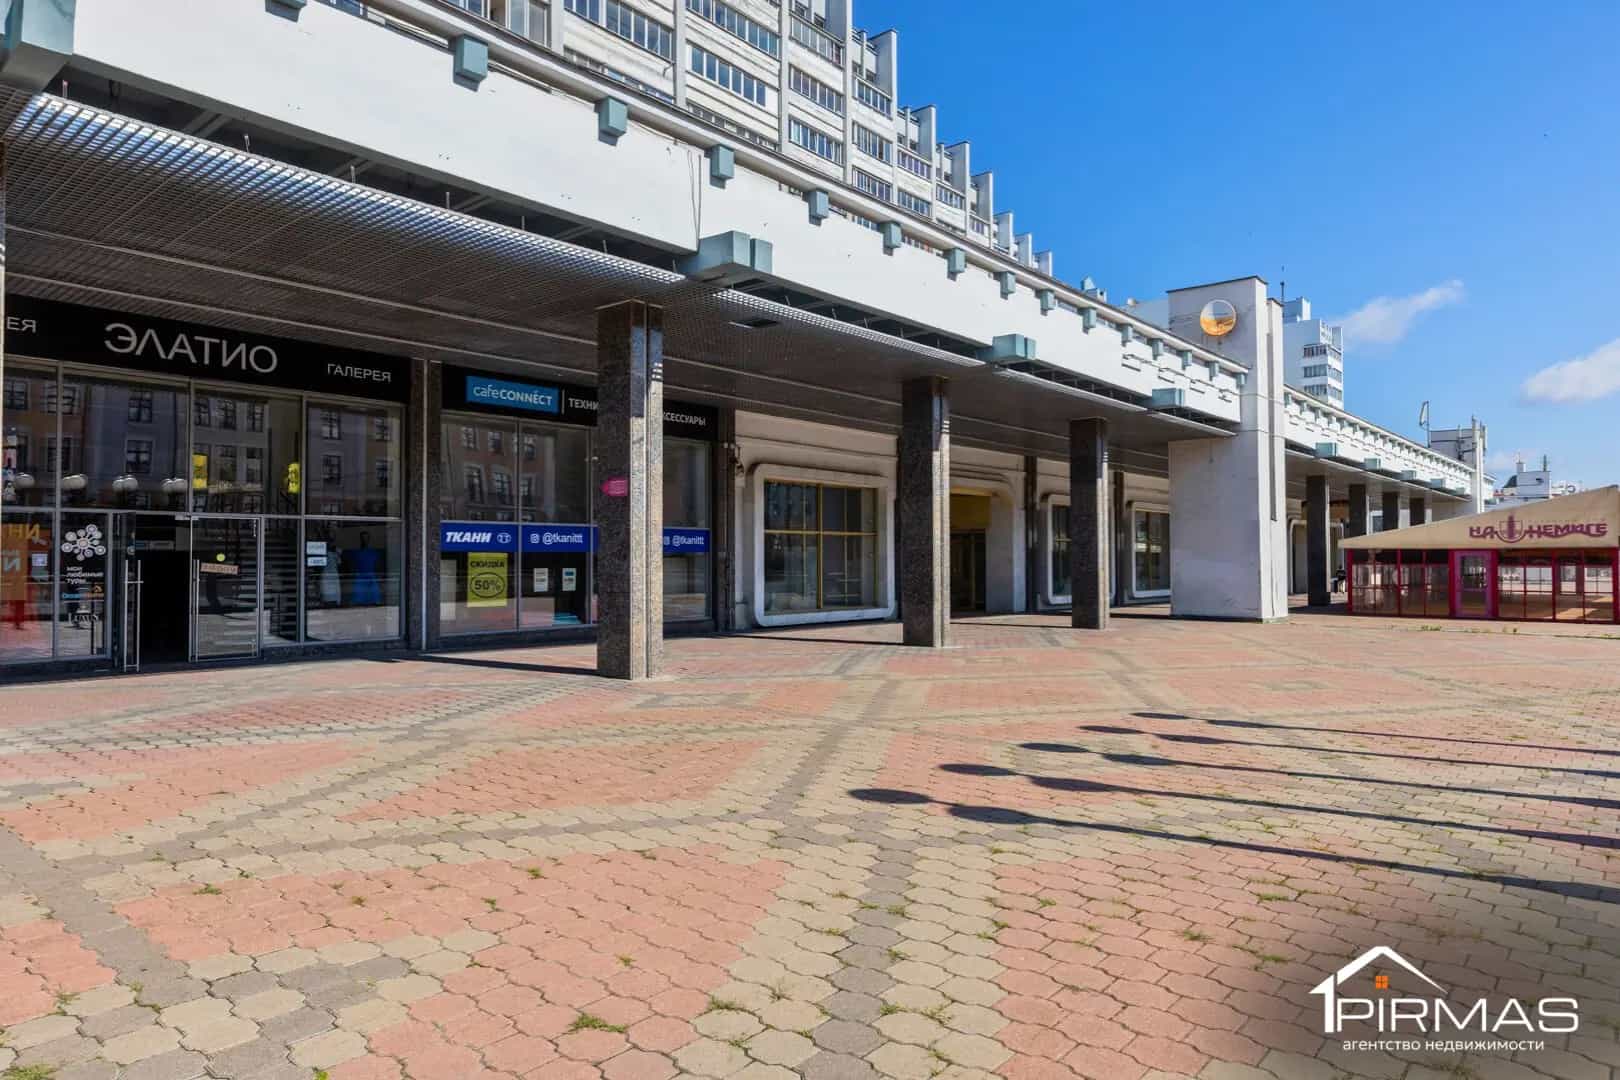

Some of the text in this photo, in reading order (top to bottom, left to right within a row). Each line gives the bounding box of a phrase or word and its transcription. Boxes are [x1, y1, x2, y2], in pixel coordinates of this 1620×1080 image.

[104, 323, 392, 383] ЭЛАТИО ГАЛЕРЕЯ
[446, 532, 492, 543] ТКАНИ
[474, 579, 502, 591] 50%
